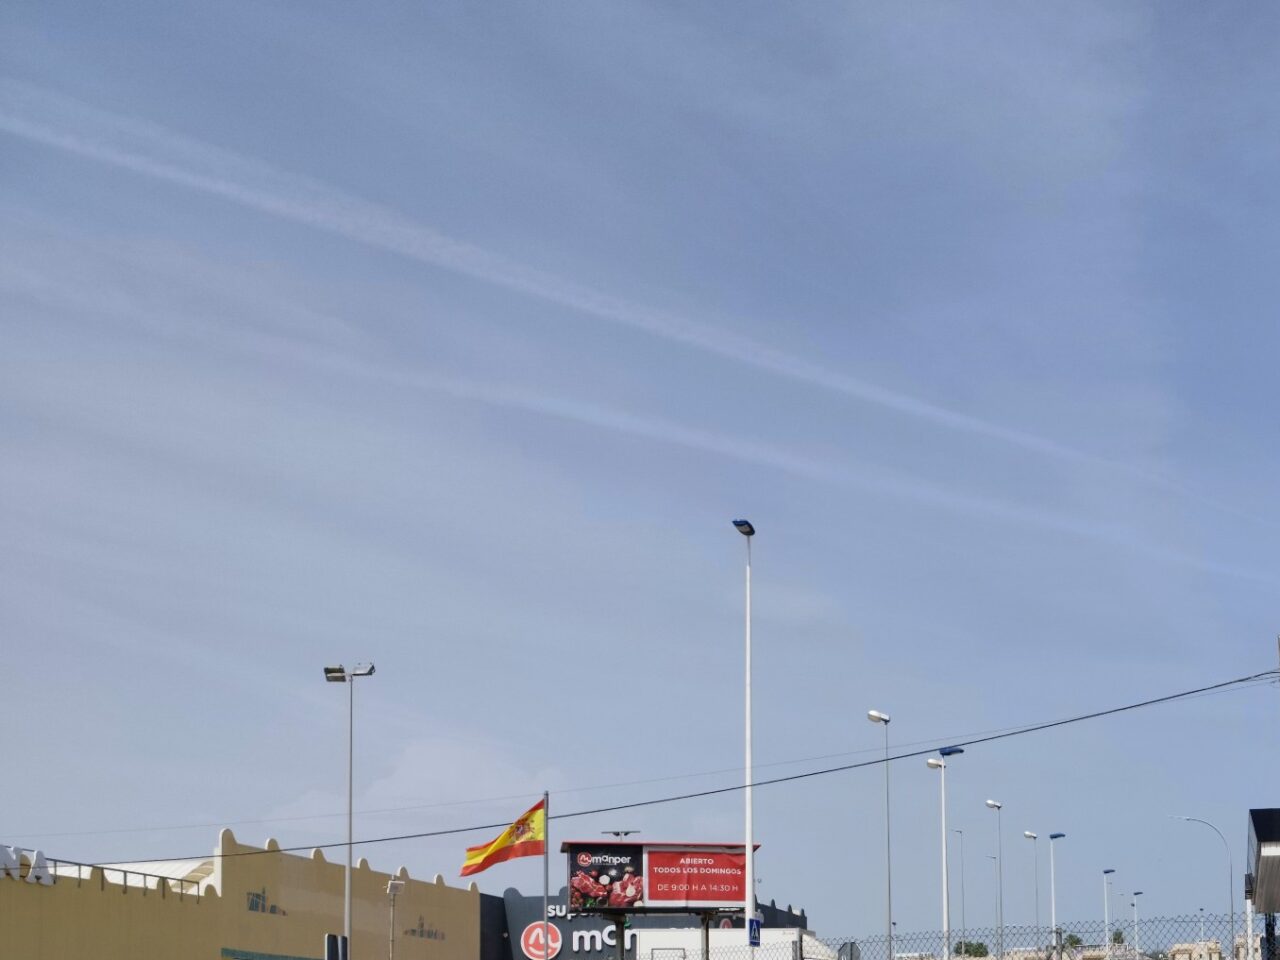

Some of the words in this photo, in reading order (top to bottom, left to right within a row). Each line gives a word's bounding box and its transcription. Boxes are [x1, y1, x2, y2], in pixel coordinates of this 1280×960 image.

[591, 854, 631, 865] manper
[700, 867, 741, 875] DOMINGOS
[671, 883, 690, 891] 9:00
[732, 884, 739, 892] H
